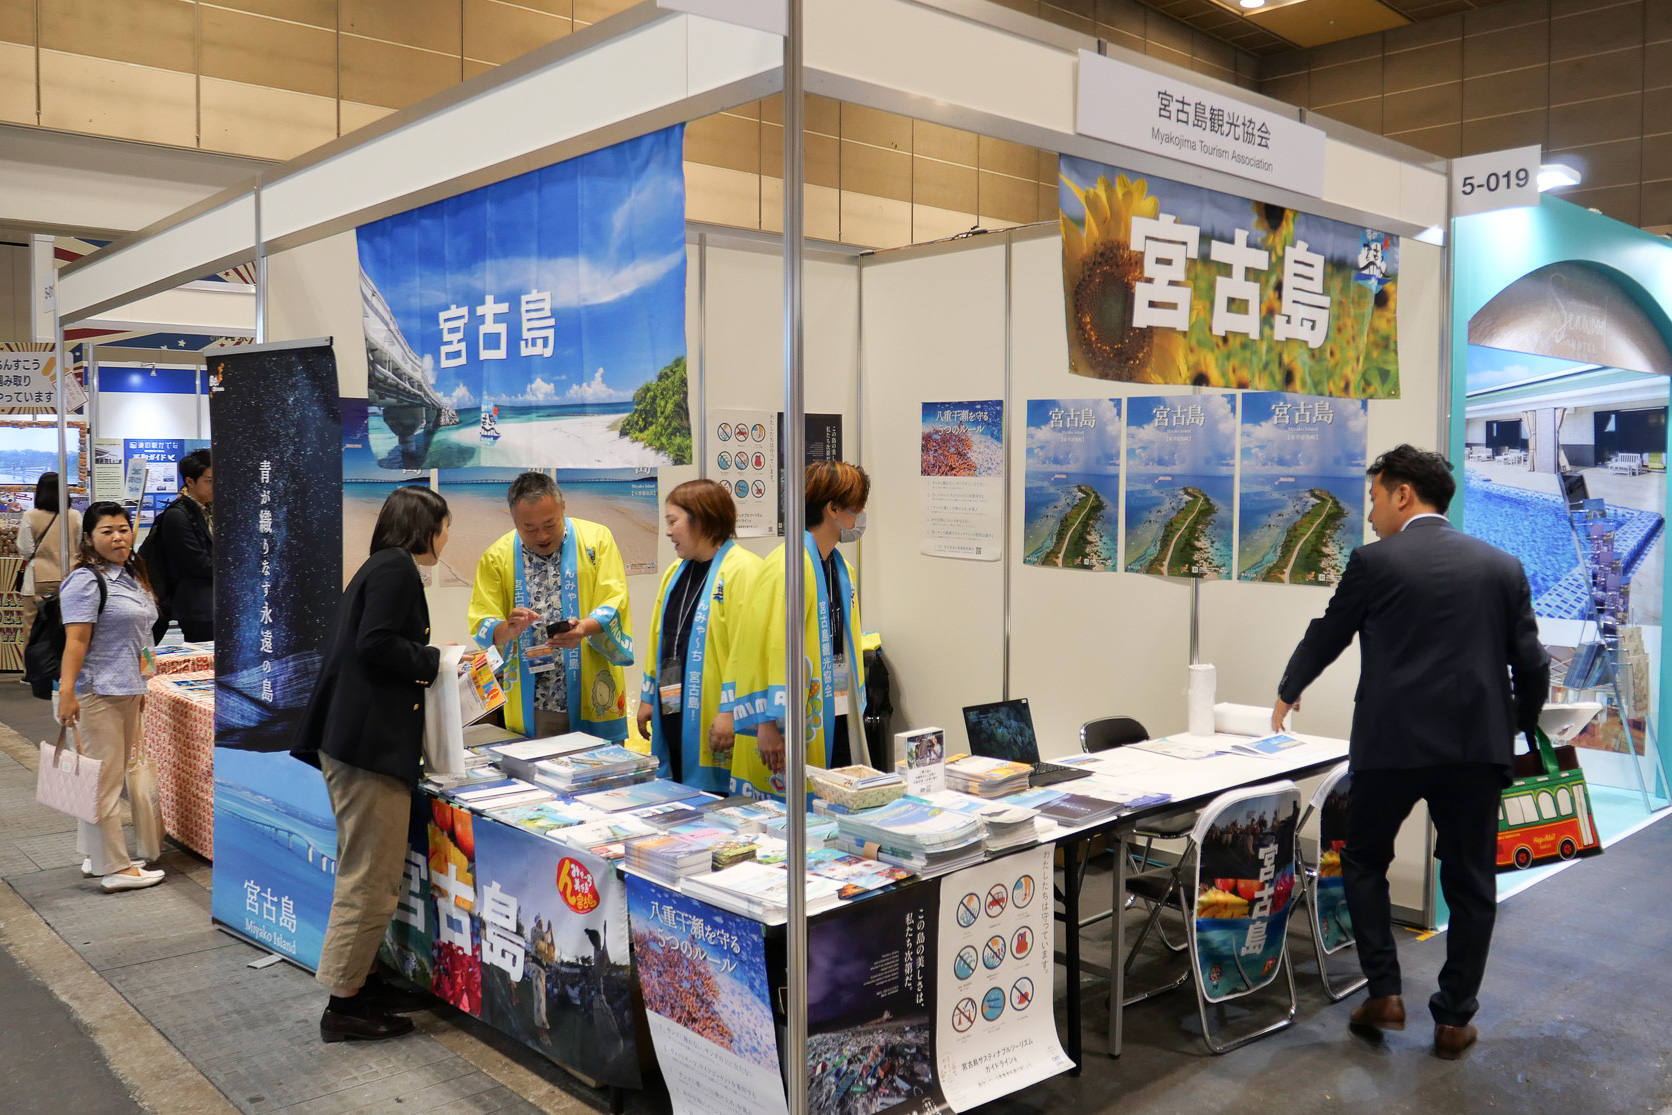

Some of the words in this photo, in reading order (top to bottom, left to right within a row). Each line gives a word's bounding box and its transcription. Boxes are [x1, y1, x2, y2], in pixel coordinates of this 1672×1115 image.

[1157, 89, 1271, 150] 宮古島観光協会
[1151, 126, 1197, 151] Myakojima
[1199, 139, 1230, 160] Tourism
[1231, 149, 1273, 173] Association
[1461, 167, 1530, 196] 5-019
[1130, 213, 1331, 349] 宮古島
[438, 289, 556, 369] 宮古島
[0, 359, 41, 371] んすこう
[0, 374, 32, 387] み取り
[1049, 408, 1097, 429] 宮古島
[1152, 405, 1206, 427] 宮古島
[1271, 400, 1334, 425] 宮古島
[258, 460, 273, 703] 青が織りなす永遠の島
[243, 880, 297, 933] 宮古島
[1041, 851, 1051, 975] わたしたちは守っています。
[1241, 842, 1280, 957] 宮古島
[245, 917, 272, 942] Miyako
[273, 932, 297, 955] Island
[649, 900, 741, 954] 八重干瀬を守る
[657, 928, 739, 973] 5つのルール
[904, 912, 915, 991] 私たち次第だ。
[916, 908, 925, 1008] この島の美しさは、
